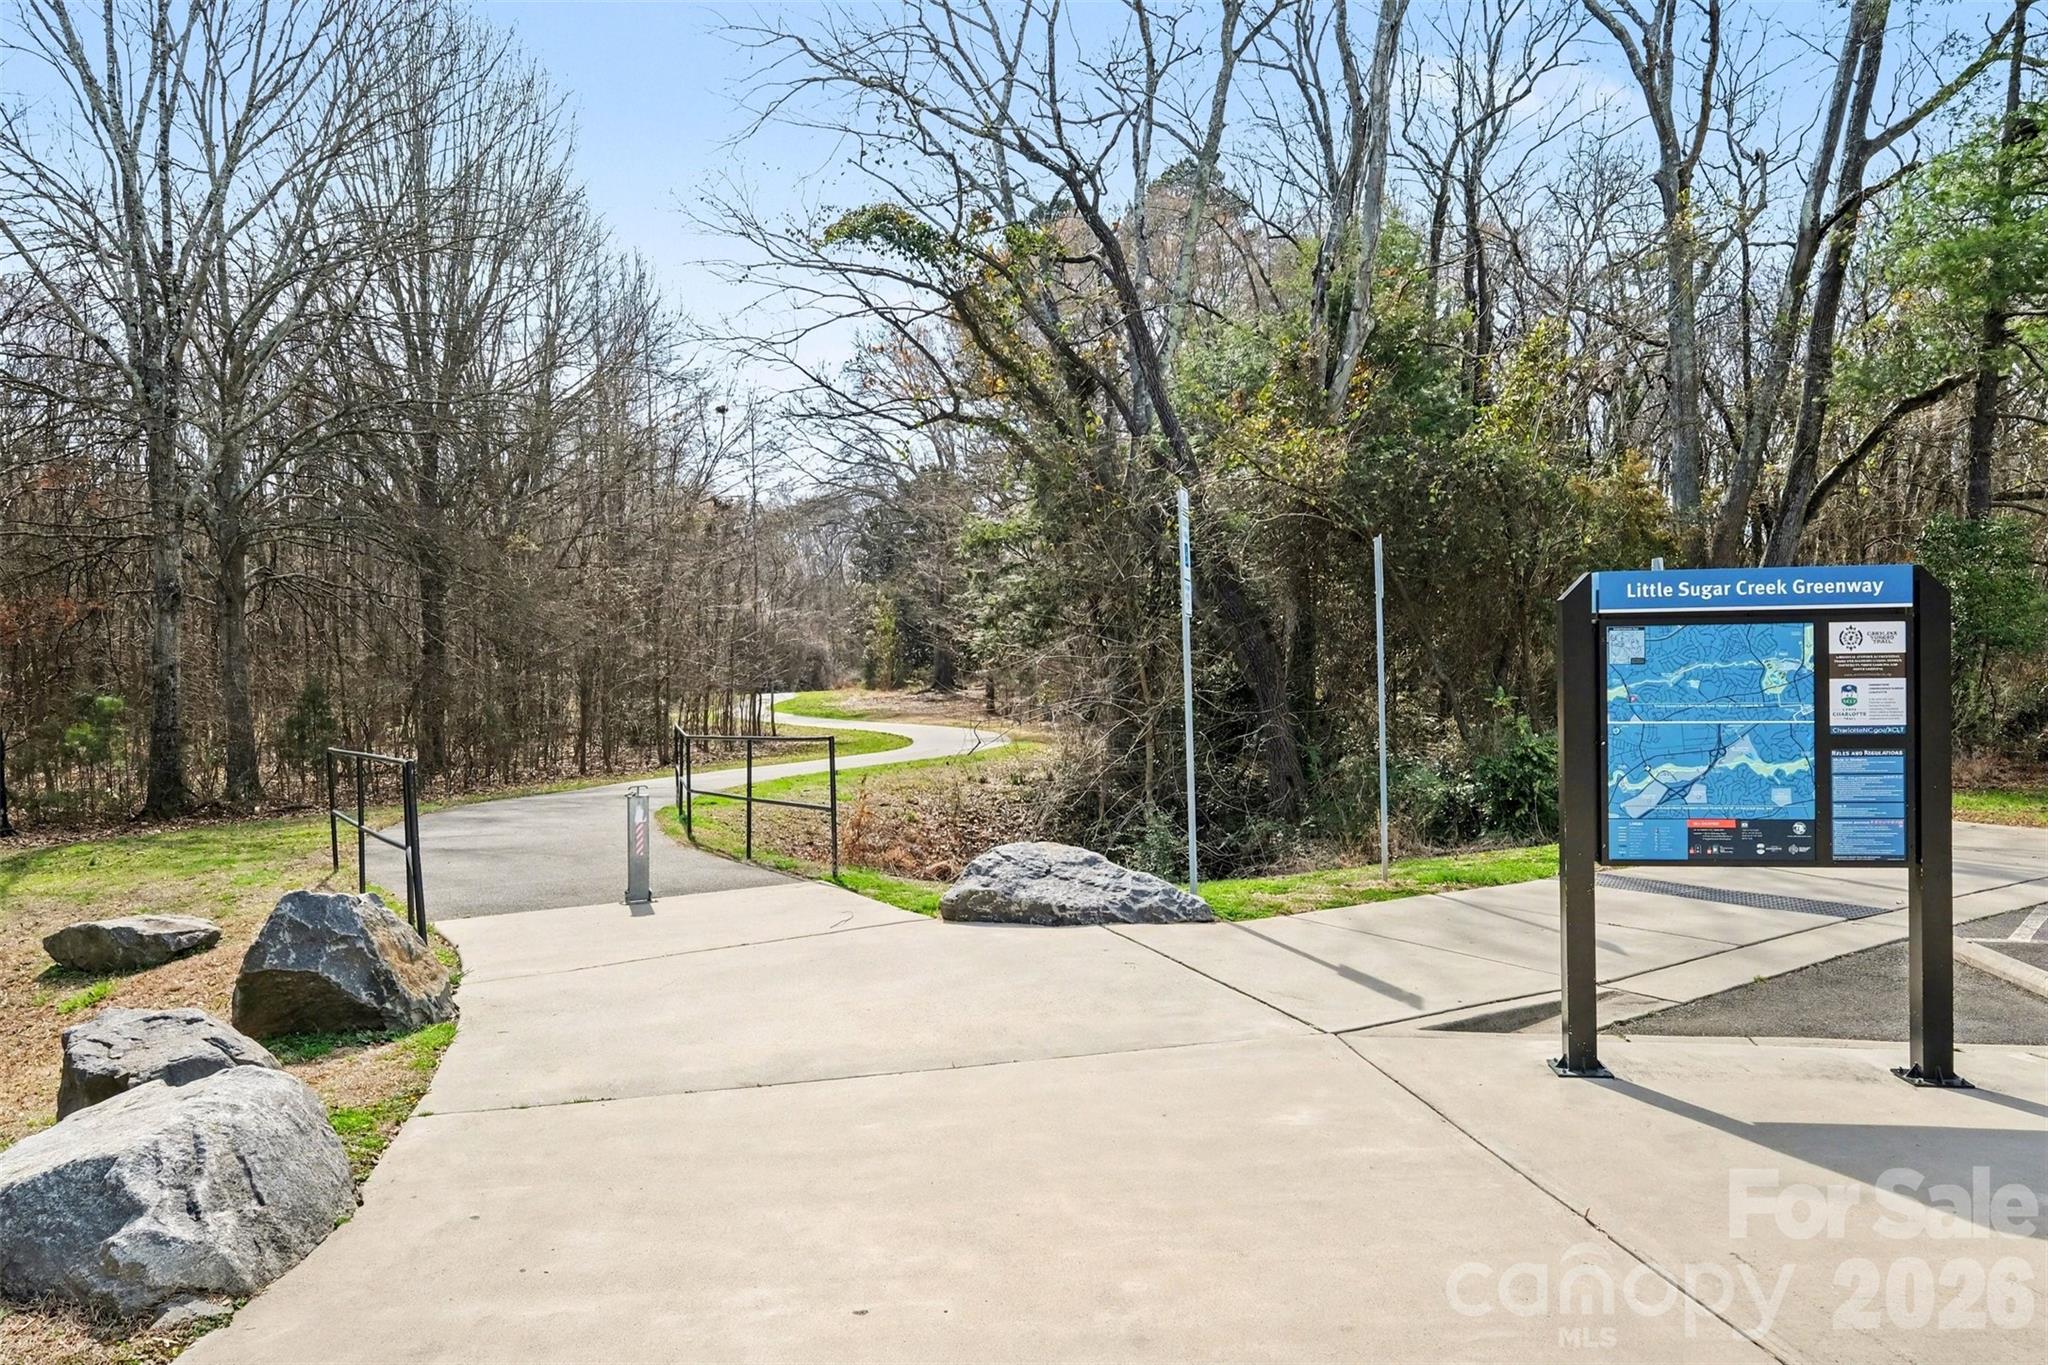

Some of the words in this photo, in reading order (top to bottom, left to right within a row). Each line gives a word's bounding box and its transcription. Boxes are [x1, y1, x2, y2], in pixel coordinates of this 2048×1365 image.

[1626, 582, 1673, 599] Little
[1678, 581, 1731, 600] Sugar
[1735, 579, 1788, 596] Creek
[1792, 578, 1884, 596] Greenway
